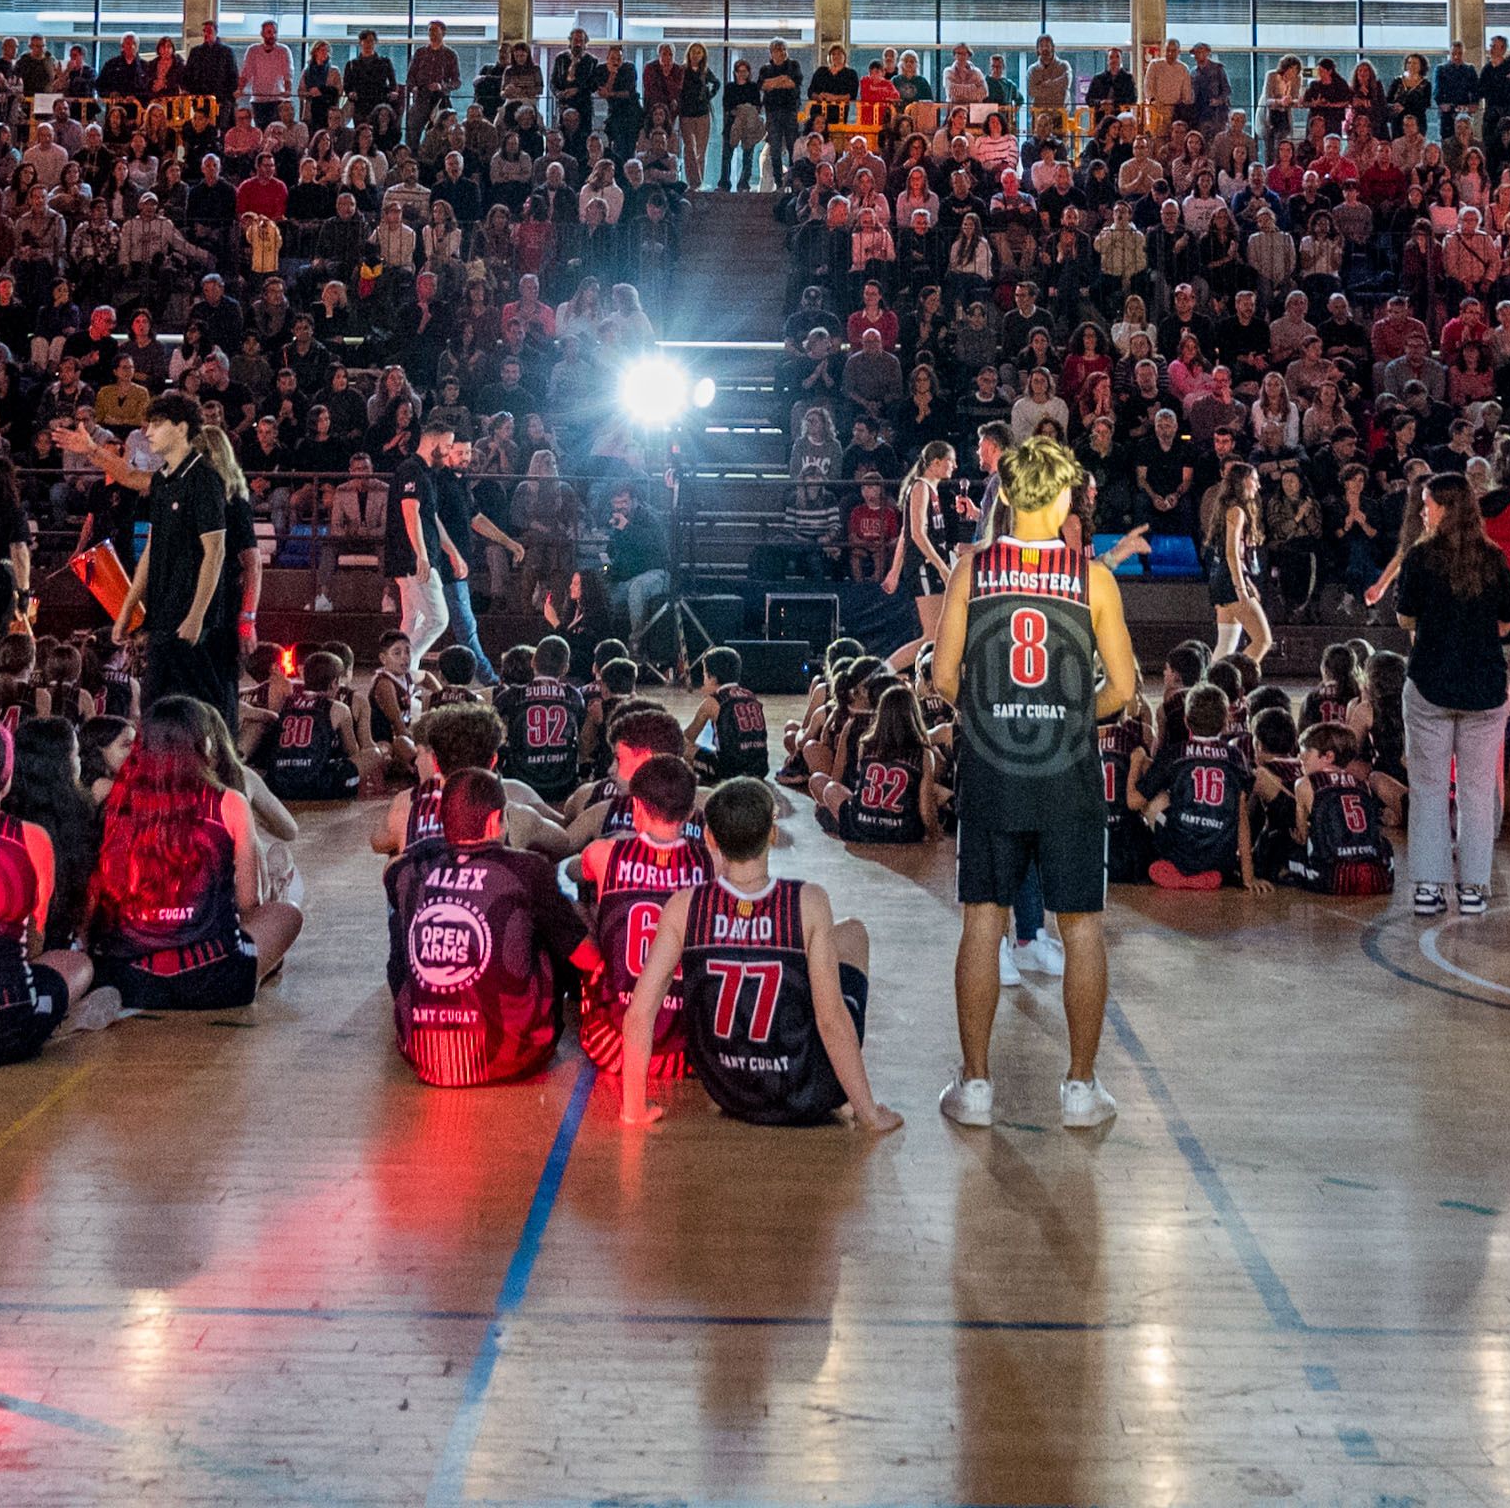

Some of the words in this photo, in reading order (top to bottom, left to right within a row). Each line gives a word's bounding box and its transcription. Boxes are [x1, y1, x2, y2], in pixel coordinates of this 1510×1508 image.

[977, 570, 1082, 594] LLAGOSTERA
[1009, 607, 1049, 689] 8
[992, 703, 1025, 719] SANT
[1026, 703, 1067, 720] CUGAT
[279, 715, 314, 749] 30
[526, 704, 568, 748] 92
[860, 762, 909, 814] 32
[1191, 766, 1226, 807] 16
[1340, 794, 1368, 834] 5
[425, 866, 489, 892] ALEX
[617, 860, 704, 886] MORILLO
[158, 907, 195, 921] CUGAT
[713, 913, 773, 940] DAVID
[420, 925, 471, 946] OPEN
[420, 943, 470, 964] ARMS
[706, 958, 783, 1044] 77
[412, 1007, 437, 1023] ANT
[438, 1008, 479, 1024] CUGAT
[718, 1052, 747, 1070] SANT
[748, 1055, 789, 1073] CUGAT
